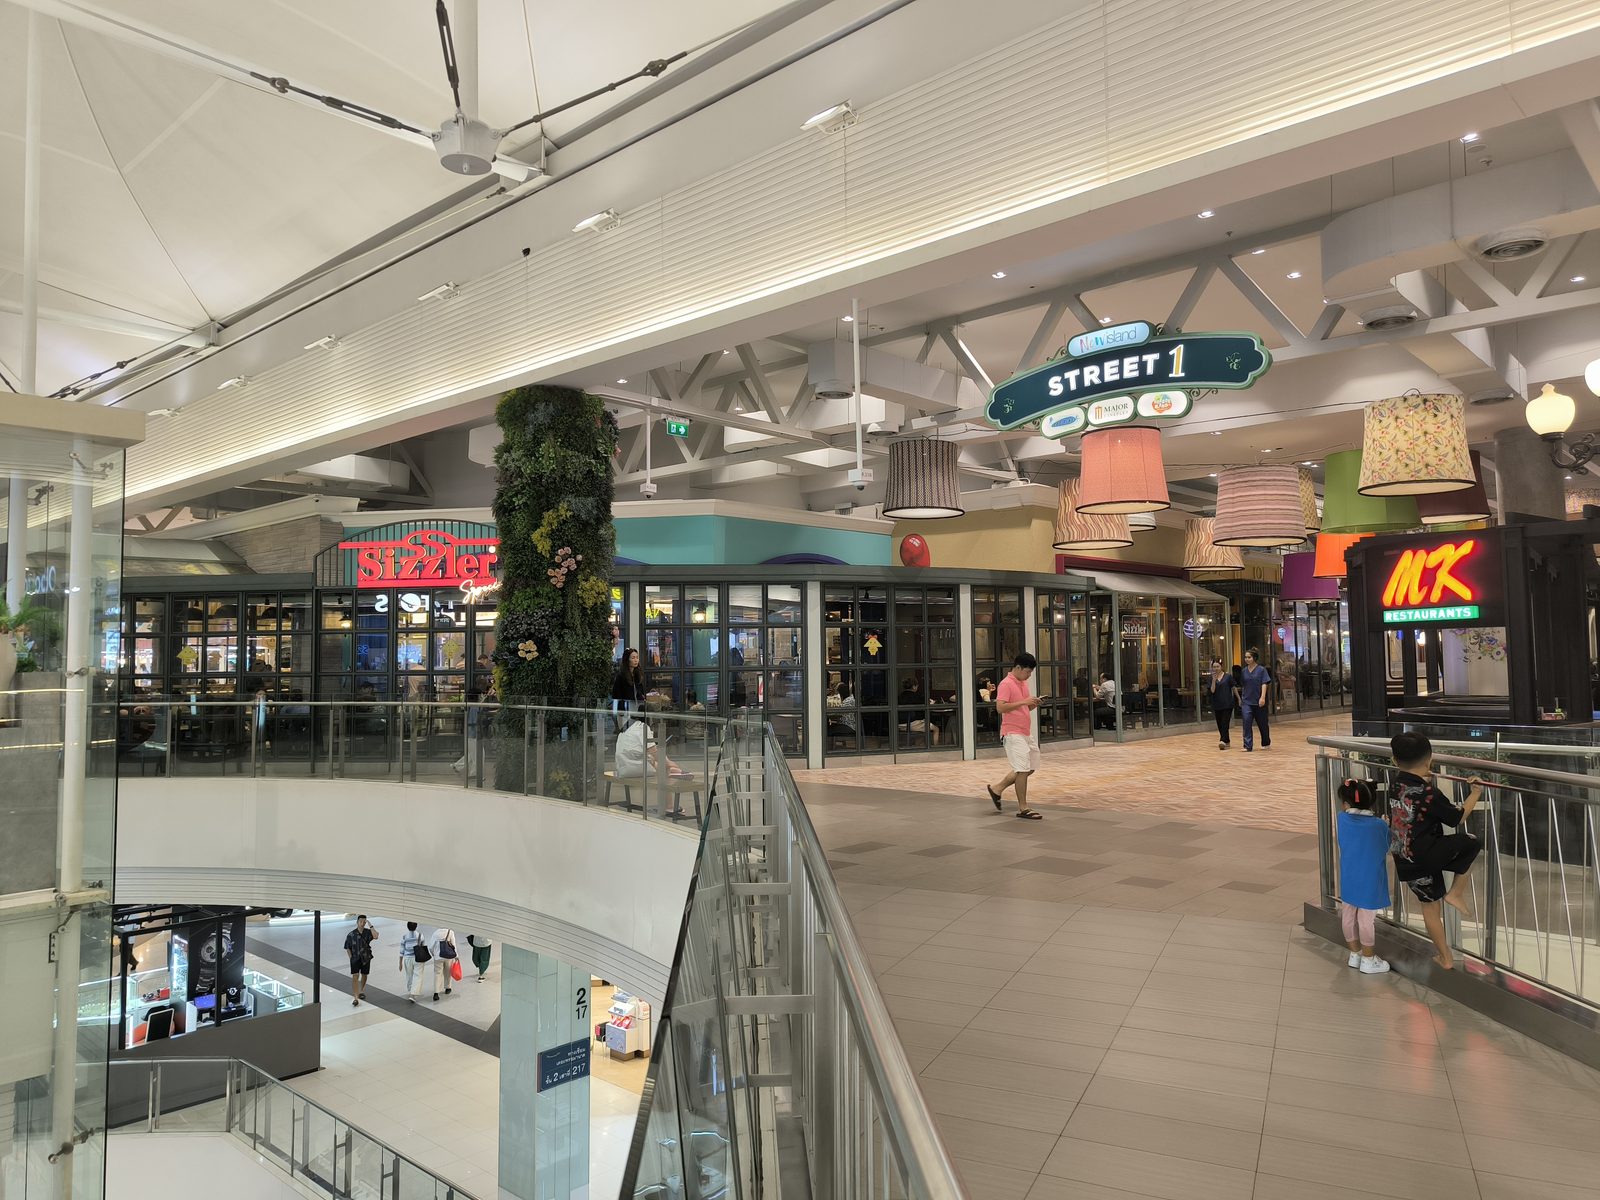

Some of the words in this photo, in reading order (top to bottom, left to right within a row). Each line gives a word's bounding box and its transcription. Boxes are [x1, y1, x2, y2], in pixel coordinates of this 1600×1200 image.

[1048, 353, 1160, 396] STREET
[1168, 344, 1185, 378] 1
[1104, 403, 1129, 412] MAJOR
[358, 535, 498, 579] Sizzler
[1382, 540, 1474, 607] MK
[1385, 607, 1472, 622] RESTAURANTS
[1123, 622, 1146, 635] Sizzler
[576, 987, 586, 1006] 2
[575, 1005, 588, 1020] 17
[553, 1072, 559, 1082] 2
[572, 1062, 586, 1076] 217
